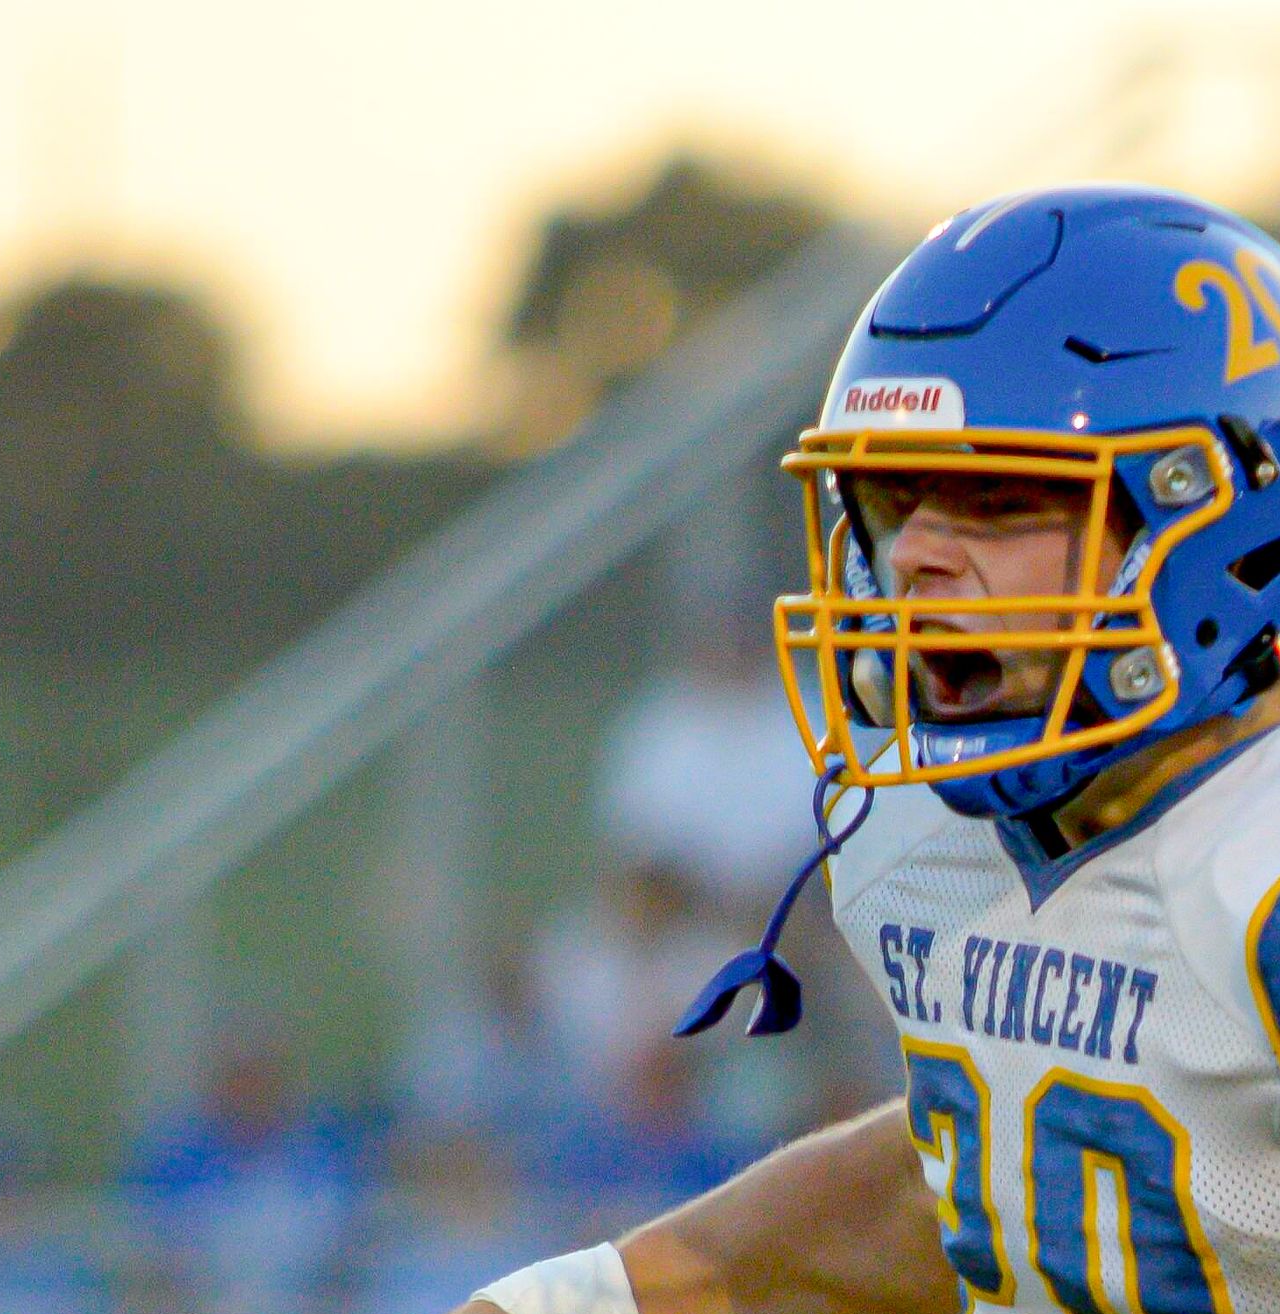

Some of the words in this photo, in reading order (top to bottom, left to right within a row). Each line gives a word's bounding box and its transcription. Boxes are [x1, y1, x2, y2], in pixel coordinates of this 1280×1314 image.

[844, 385, 943, 413] Riddell
[879, 924, 942, 1022] ST.
[963, 935, 1158, 1064] VINCENT
